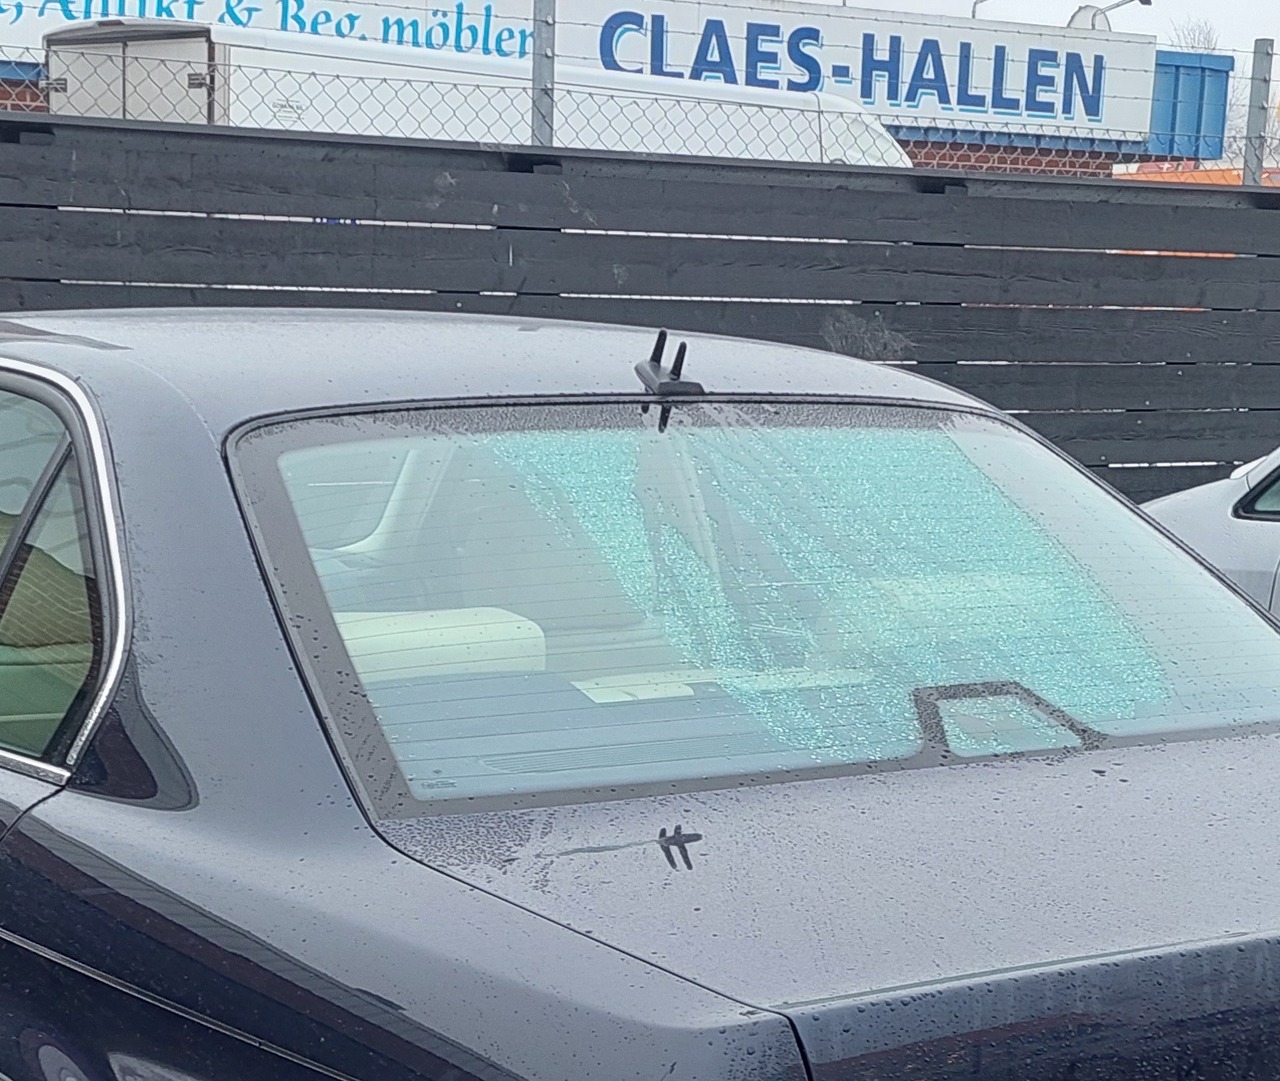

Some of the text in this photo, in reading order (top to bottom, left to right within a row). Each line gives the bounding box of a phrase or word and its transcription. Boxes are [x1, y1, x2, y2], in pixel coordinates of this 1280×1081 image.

[217, 0, 263, 28] &
[381, 2, 536, 57] möbler
[599, 11, 1107, 121] CLAES-HALLEN
